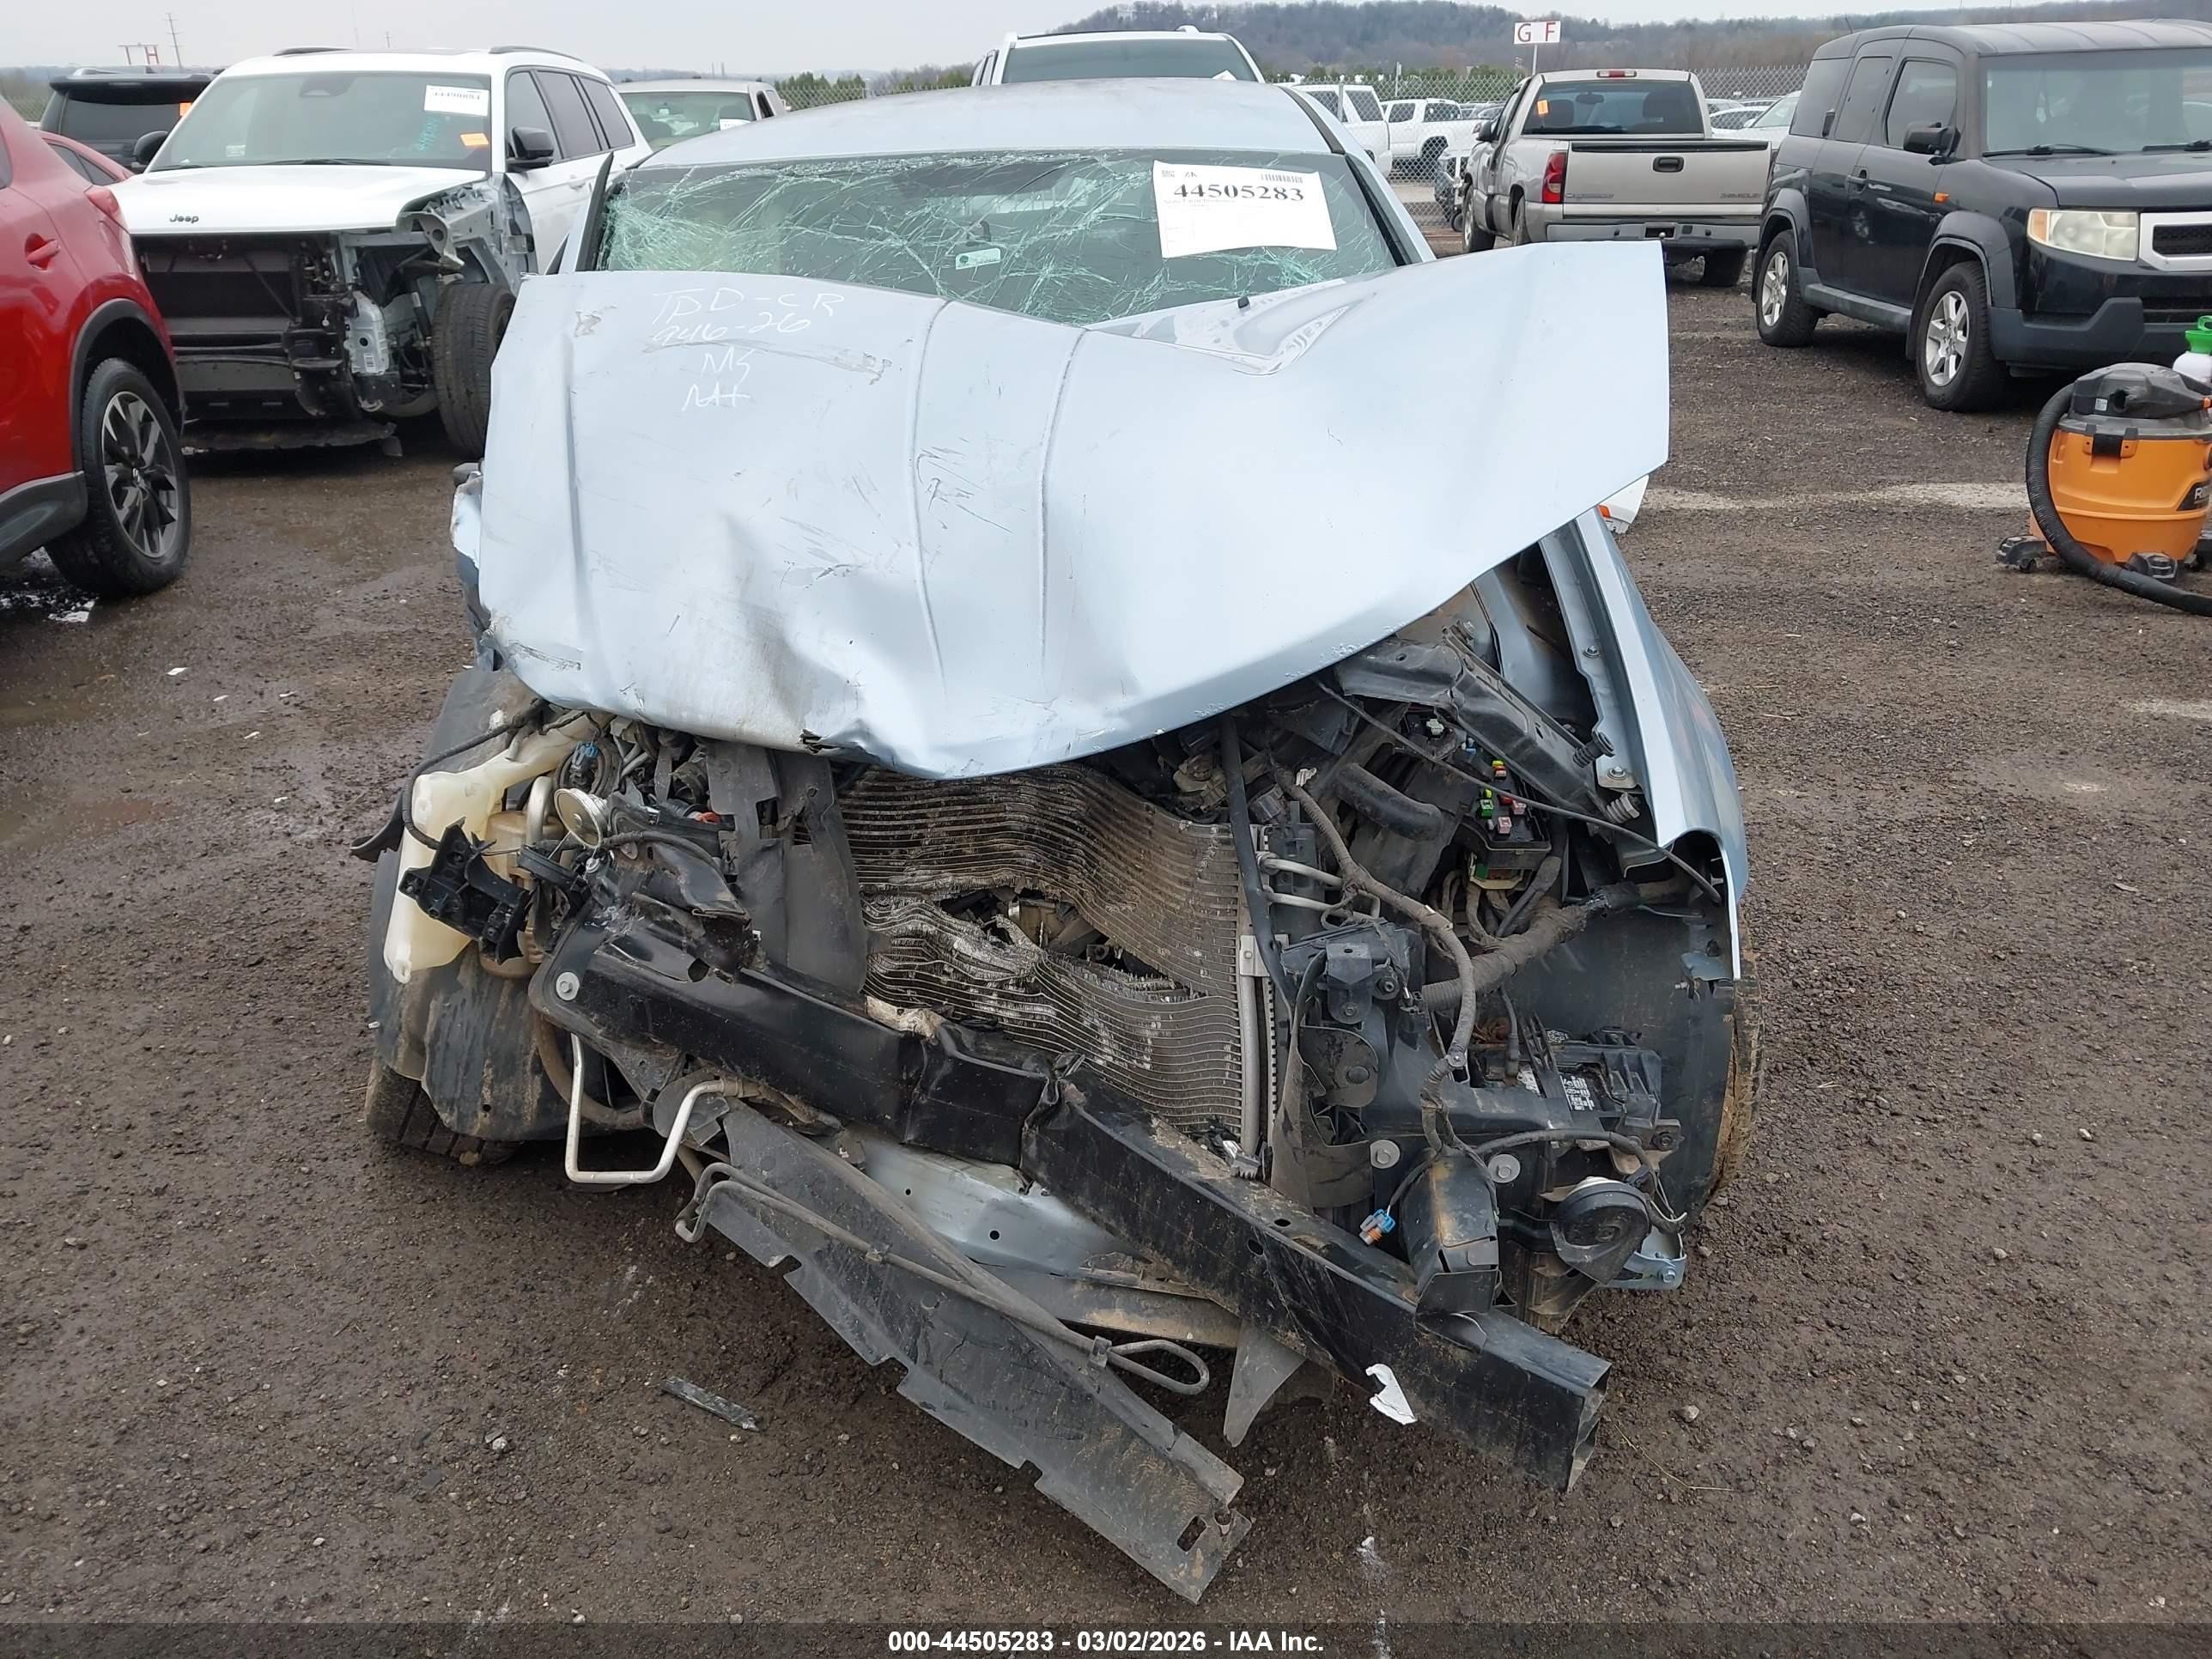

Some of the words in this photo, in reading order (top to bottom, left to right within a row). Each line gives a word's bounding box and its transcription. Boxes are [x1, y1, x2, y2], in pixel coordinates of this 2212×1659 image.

[1517, 22, 1531, 42] G
[1545, 21, 1556, 42] F
[1173, 183, 1304, 202] 44505283
[168, 214, 199, 224] Jeep
